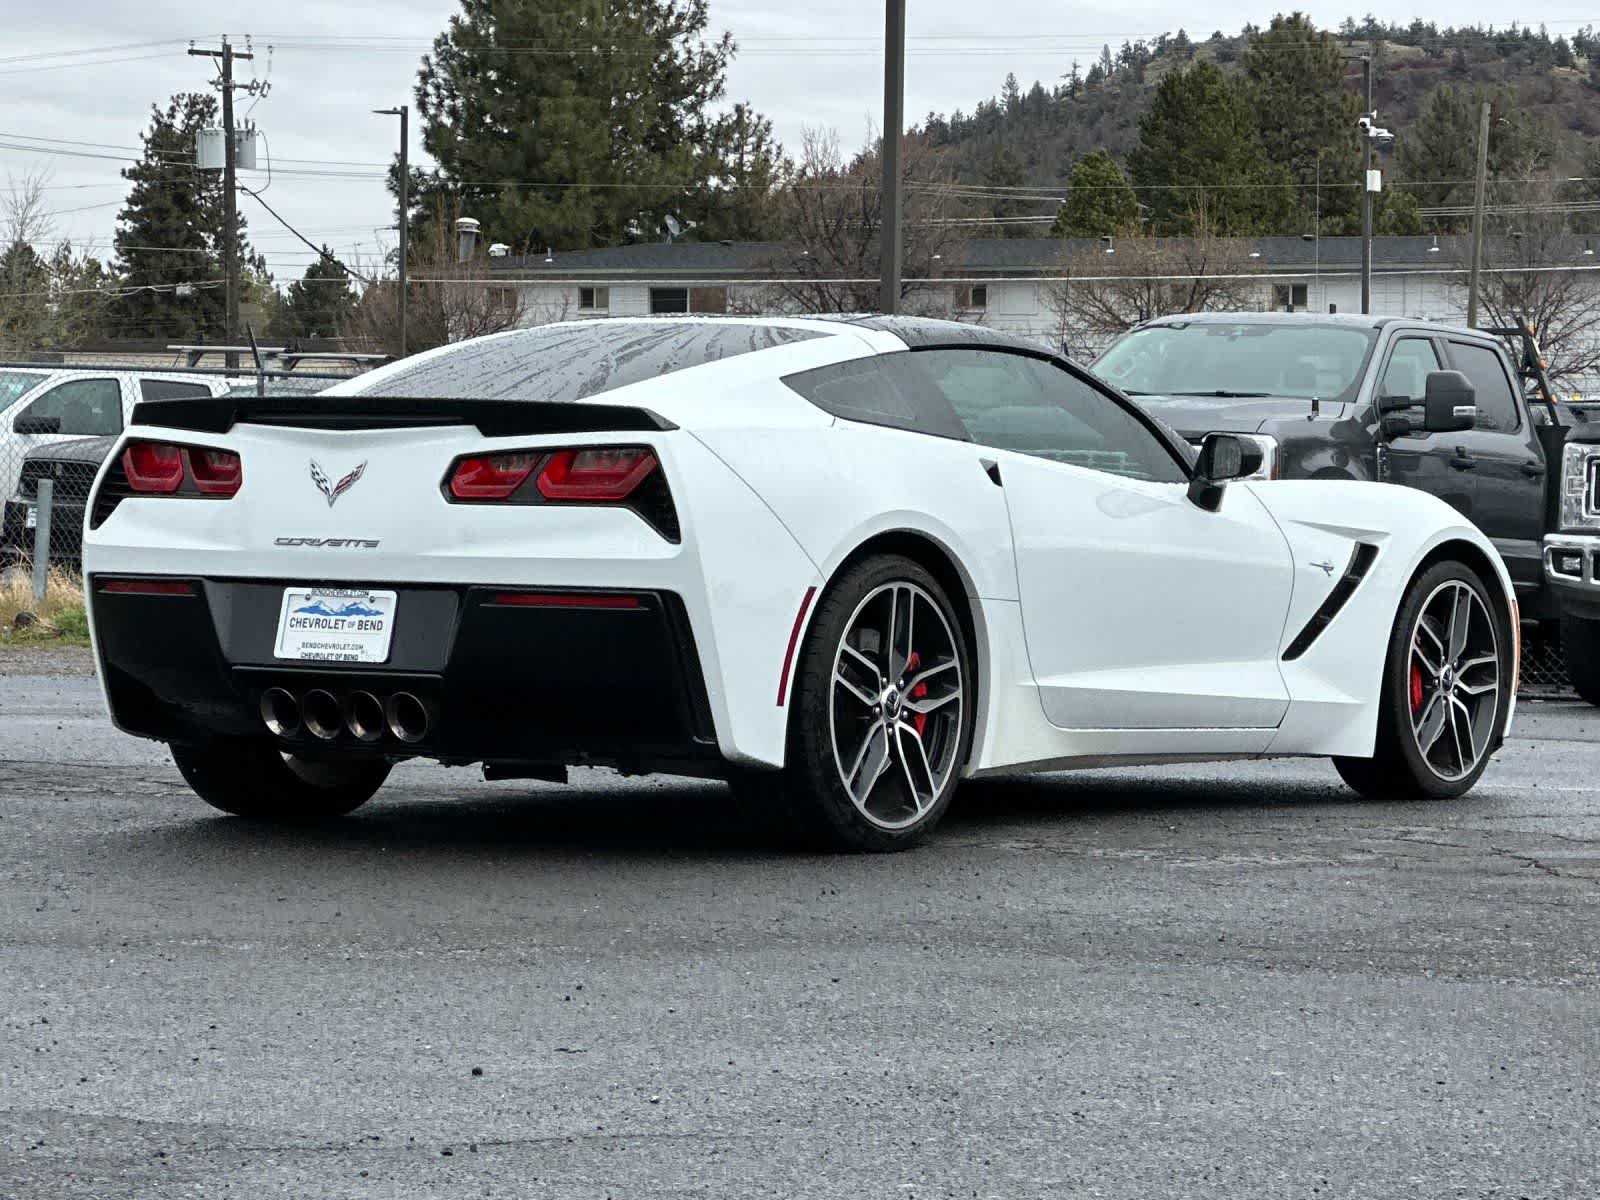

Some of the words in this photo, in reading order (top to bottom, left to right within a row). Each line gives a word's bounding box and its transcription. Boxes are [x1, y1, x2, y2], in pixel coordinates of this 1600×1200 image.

[274, 537, 380, 548] CORVETTE
[289, 617, 346, 631] CHEVROLET
[357, 619, 384, 632] BEND
[301, 641, 364, 651] BENDCHEVROLET.COM
[301, 651, 335, 661] CHEVROLET
[335, 653, 342, 661] OF
[343, 653, 359, 661] BEND
